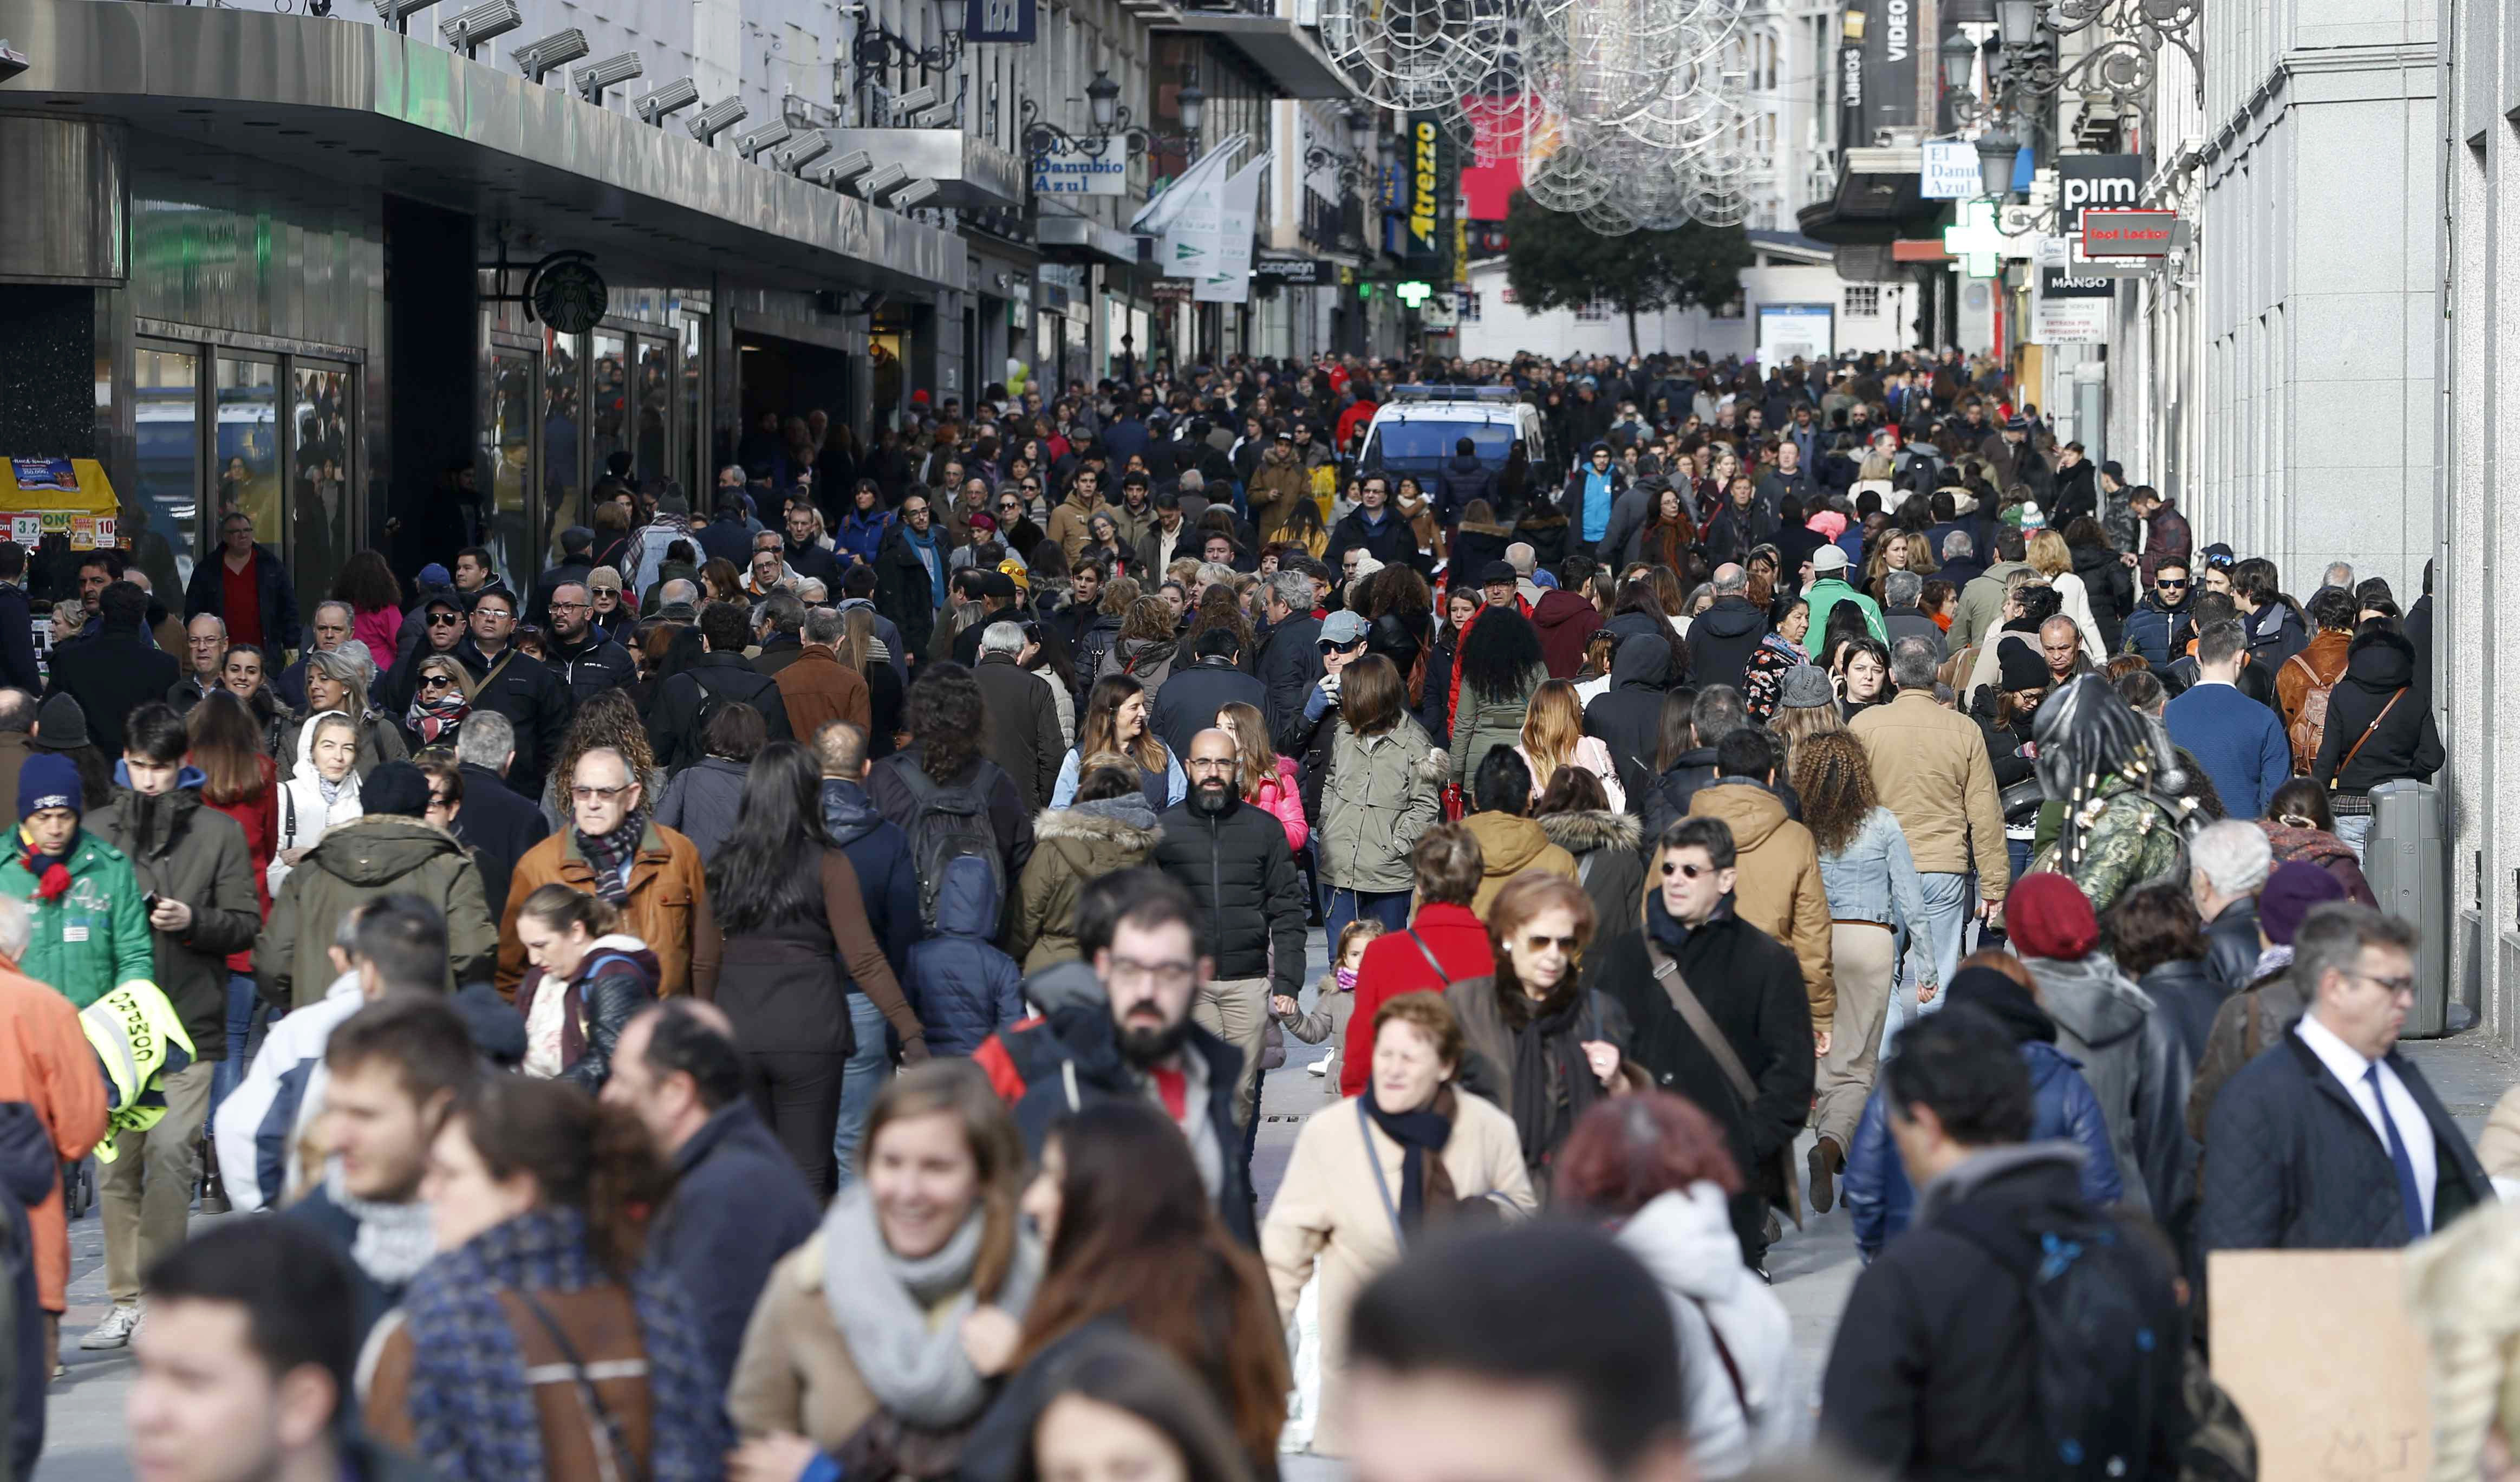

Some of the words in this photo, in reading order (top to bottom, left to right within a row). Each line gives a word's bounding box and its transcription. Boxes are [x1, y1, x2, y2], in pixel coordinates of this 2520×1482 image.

[1887, 0, 1908, 62] VIDEO
[1932, 147, 1949, 160] El
[1035, 155, 1123, 173] Danubio
[1035, 176, 1088, 191] Azul
[1410, 121, 1436, 251] Atrezzo
[1932, 180, 1971, 193] Azul
[2065, 178, 2135, 211] pim
[2052, 277, 2107, 288] MANGO
[99, 520, 113, 535] 10
